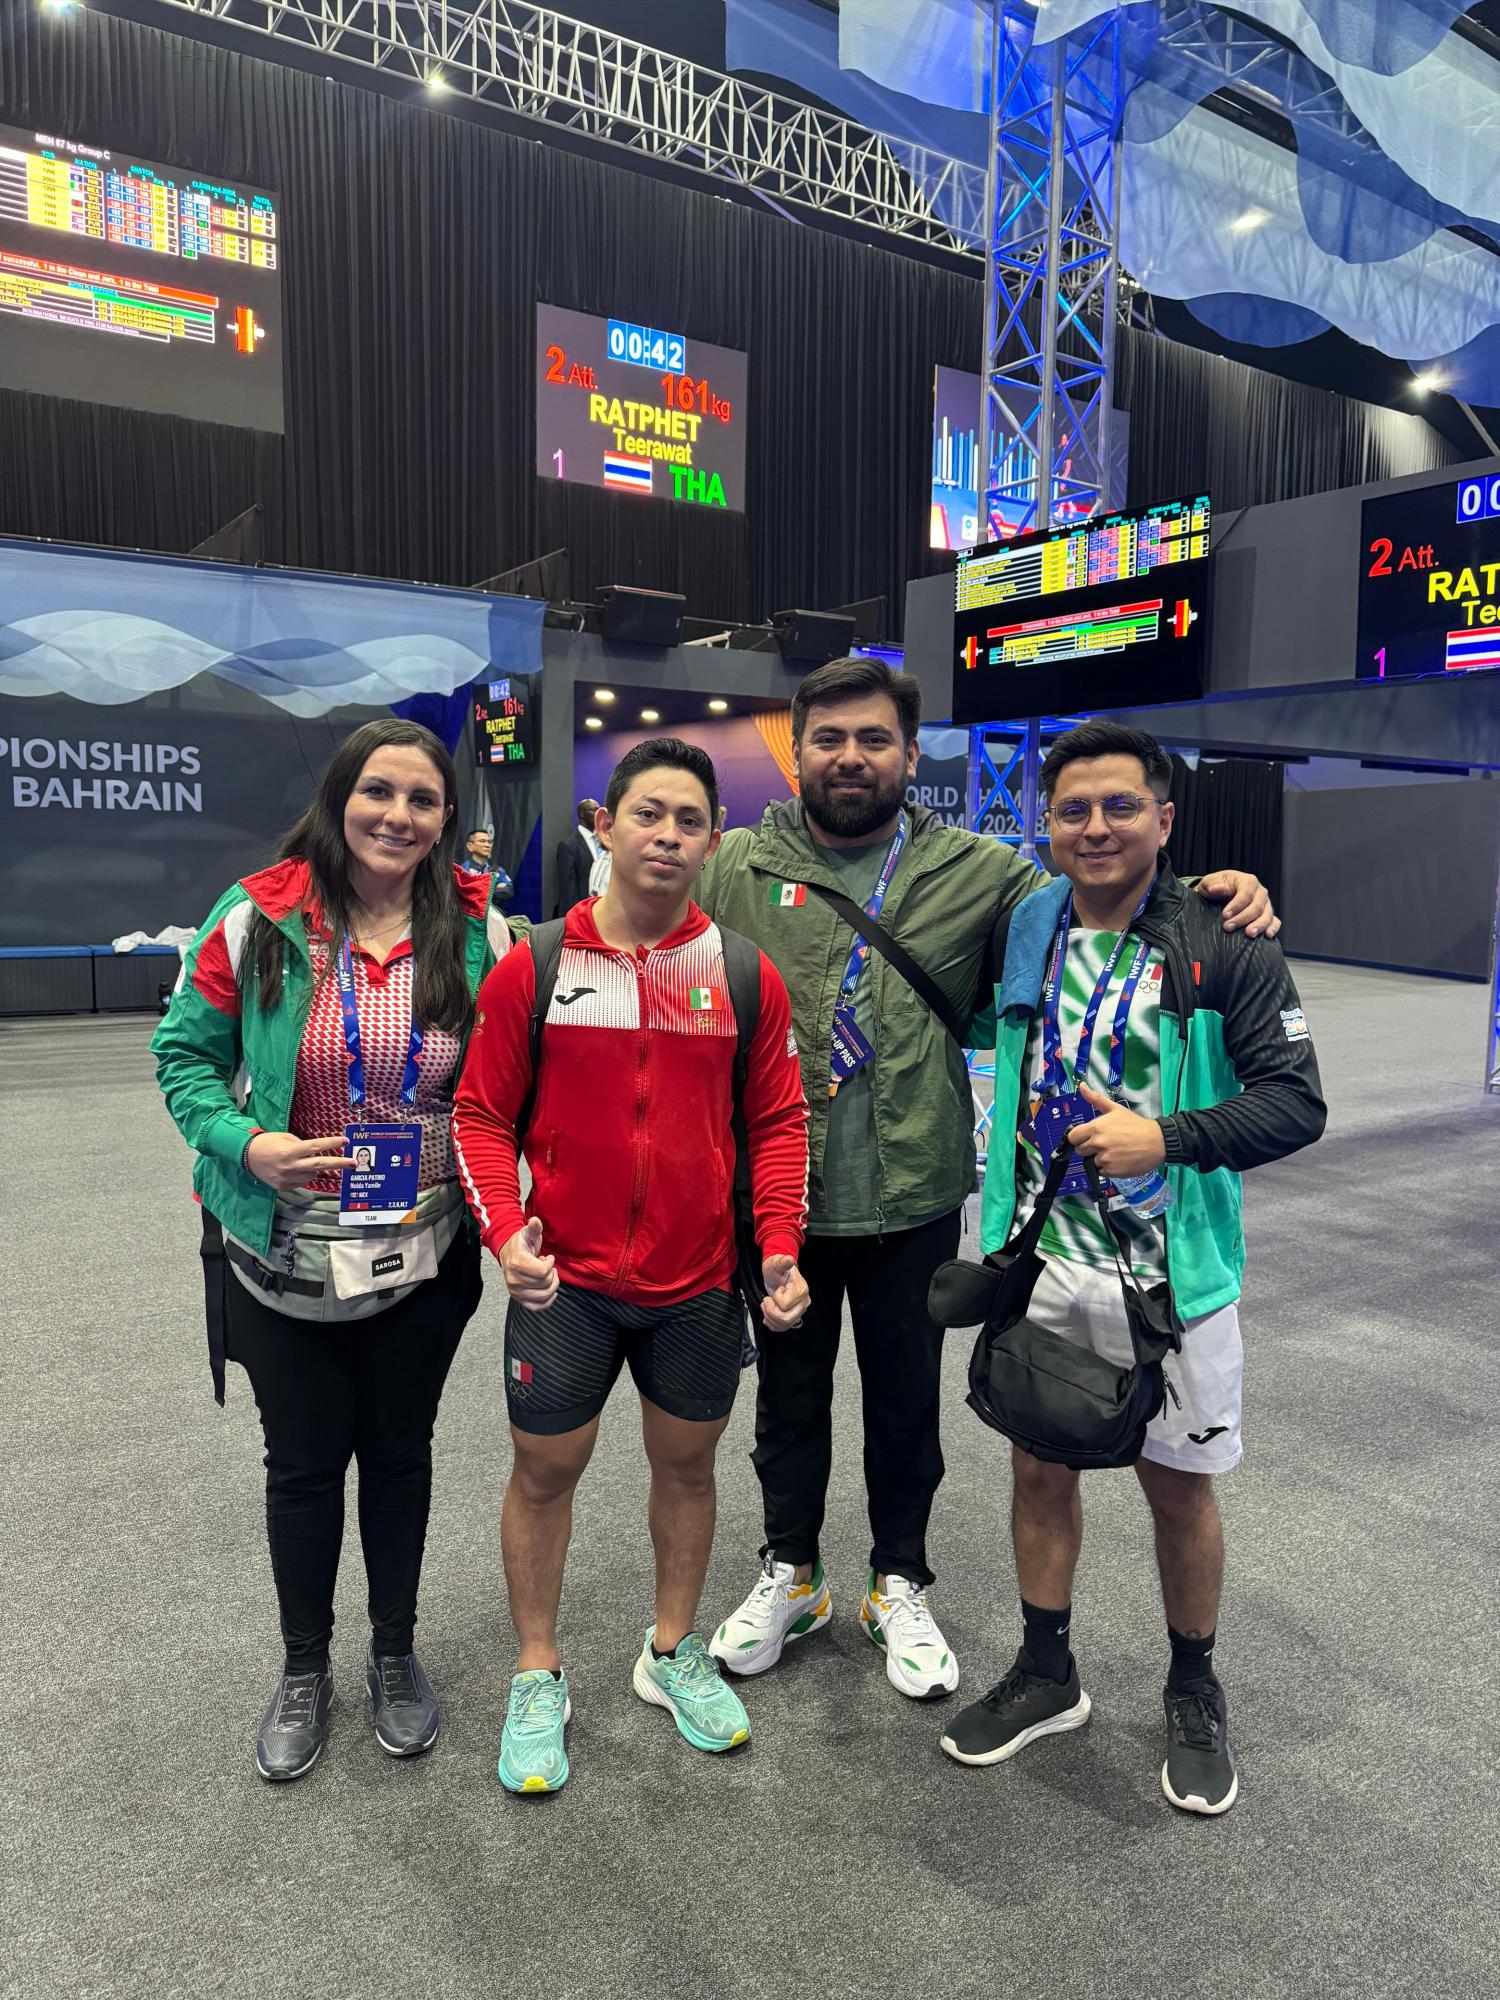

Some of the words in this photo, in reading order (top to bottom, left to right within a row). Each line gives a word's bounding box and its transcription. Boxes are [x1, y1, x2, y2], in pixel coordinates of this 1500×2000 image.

[78, 142, 102, 160] Group
[104, 150, 111, 160] C
[610, 328, 683, 369] 00:42
[546, 345, 566, 384] 2
[568, 363, 599, 390] Att.
[661, 372, 709, 414] 161
[712, 393, 731, 423] kg
[590, 393, 702, 442] RATPHET
[613, 427, 693, 465] Teerawat
[552, 447, 563, 478] 1
[669, 464, 727, 508] THA
[1368, 537, 1393, 578] 2
[1398, 544, 1440, 573] Att.
[1461, 600, 1500, 626] Te
[1373, 647, 1386, 678] 1
[475, 703, 481, 720] 2
[504, 696, 517, 715] 161
[486, 716, 516, 734] RATPHET
[507, 742, 525, 760] THA
[13, 776, 203, 812] BAHRAIN
[905, 785, 959, 808] ORLD
[983, 814, 1022, 834] 202
[874, 878, 888, 898] IWF
[1104, 952, 1118, 973] IWF
[1127, 959, 1144, 981] IWF
[341, 971, 351, 991] IWF
[1044, 982, 1056, 1003] IWF
[838, 1048, 857, 1068] PASS
[375, 1259, 400, 1271] SAROSA
